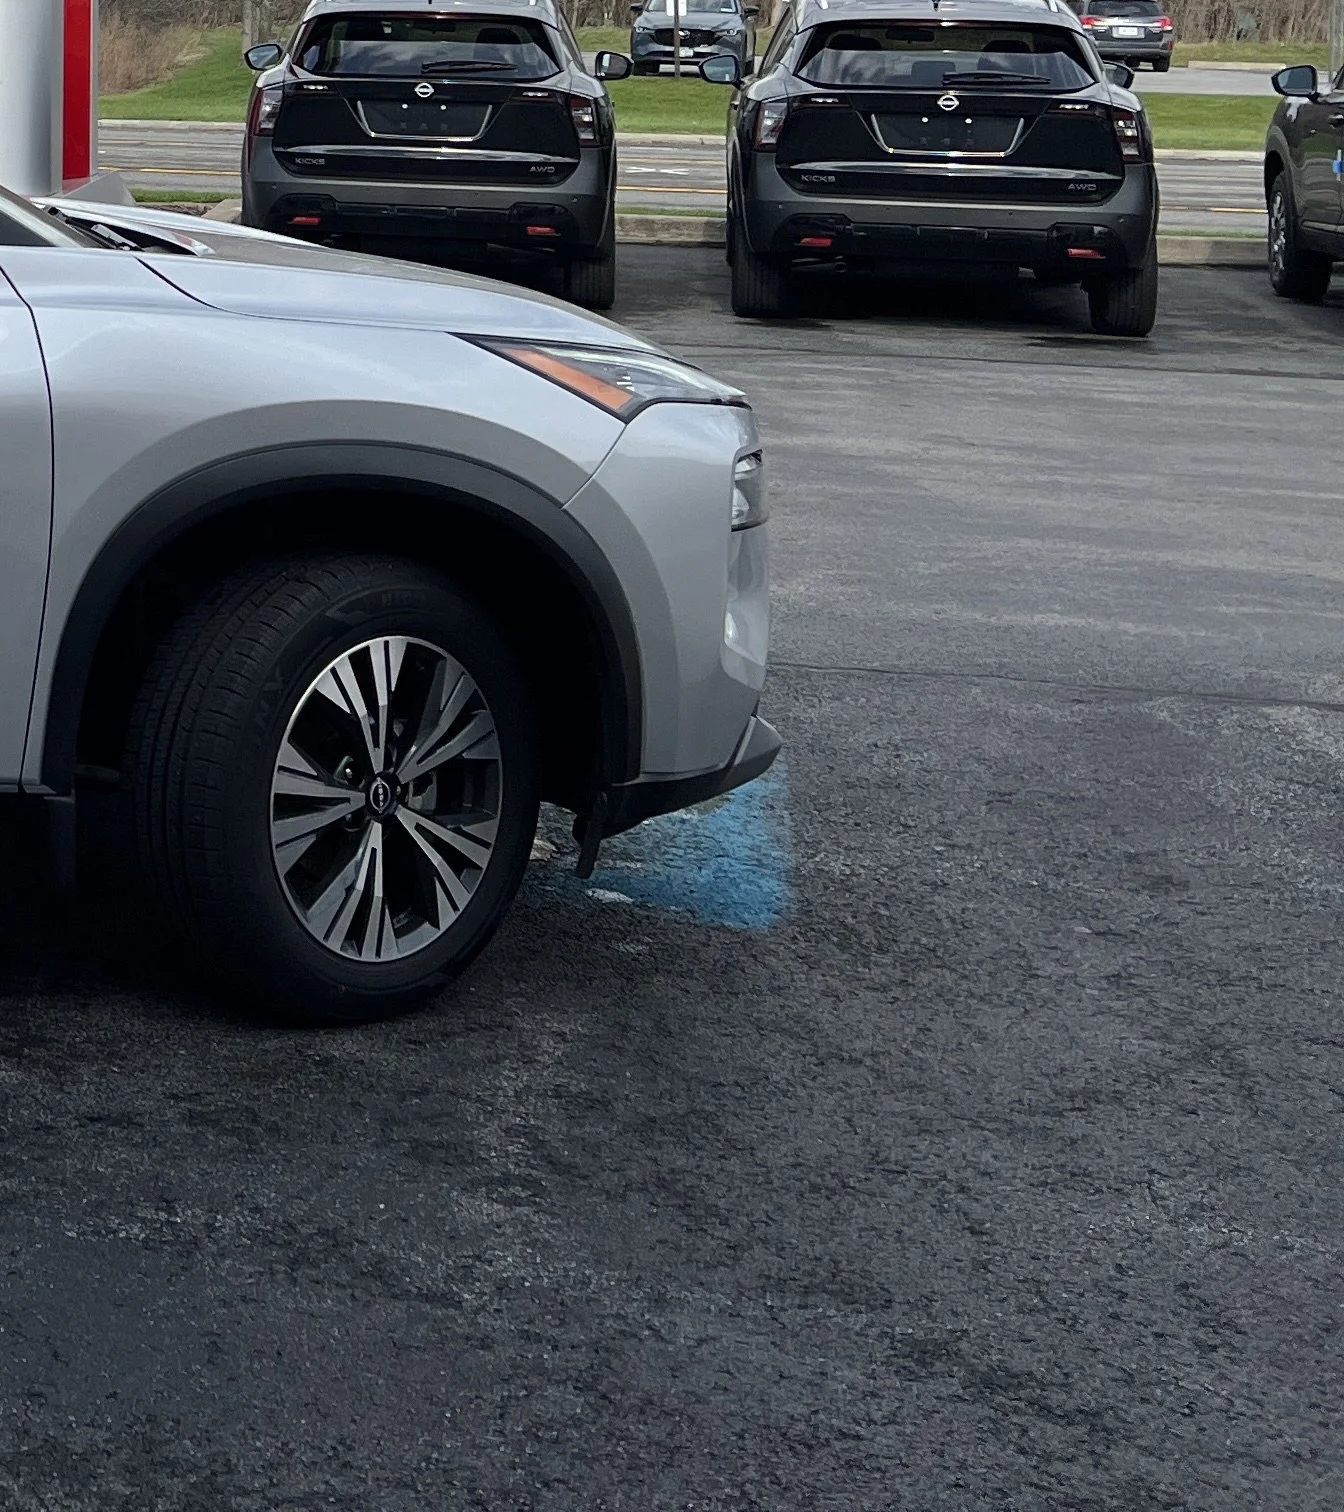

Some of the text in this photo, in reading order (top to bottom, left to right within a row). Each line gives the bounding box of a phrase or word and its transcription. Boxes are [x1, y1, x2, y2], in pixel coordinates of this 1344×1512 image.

[294, 157, 325, 166] KICKS
[529, 165, 556, 173] AWD
[800, 174, 836, 183] KICKS
[1067, 183, 1097, 191] AWD
